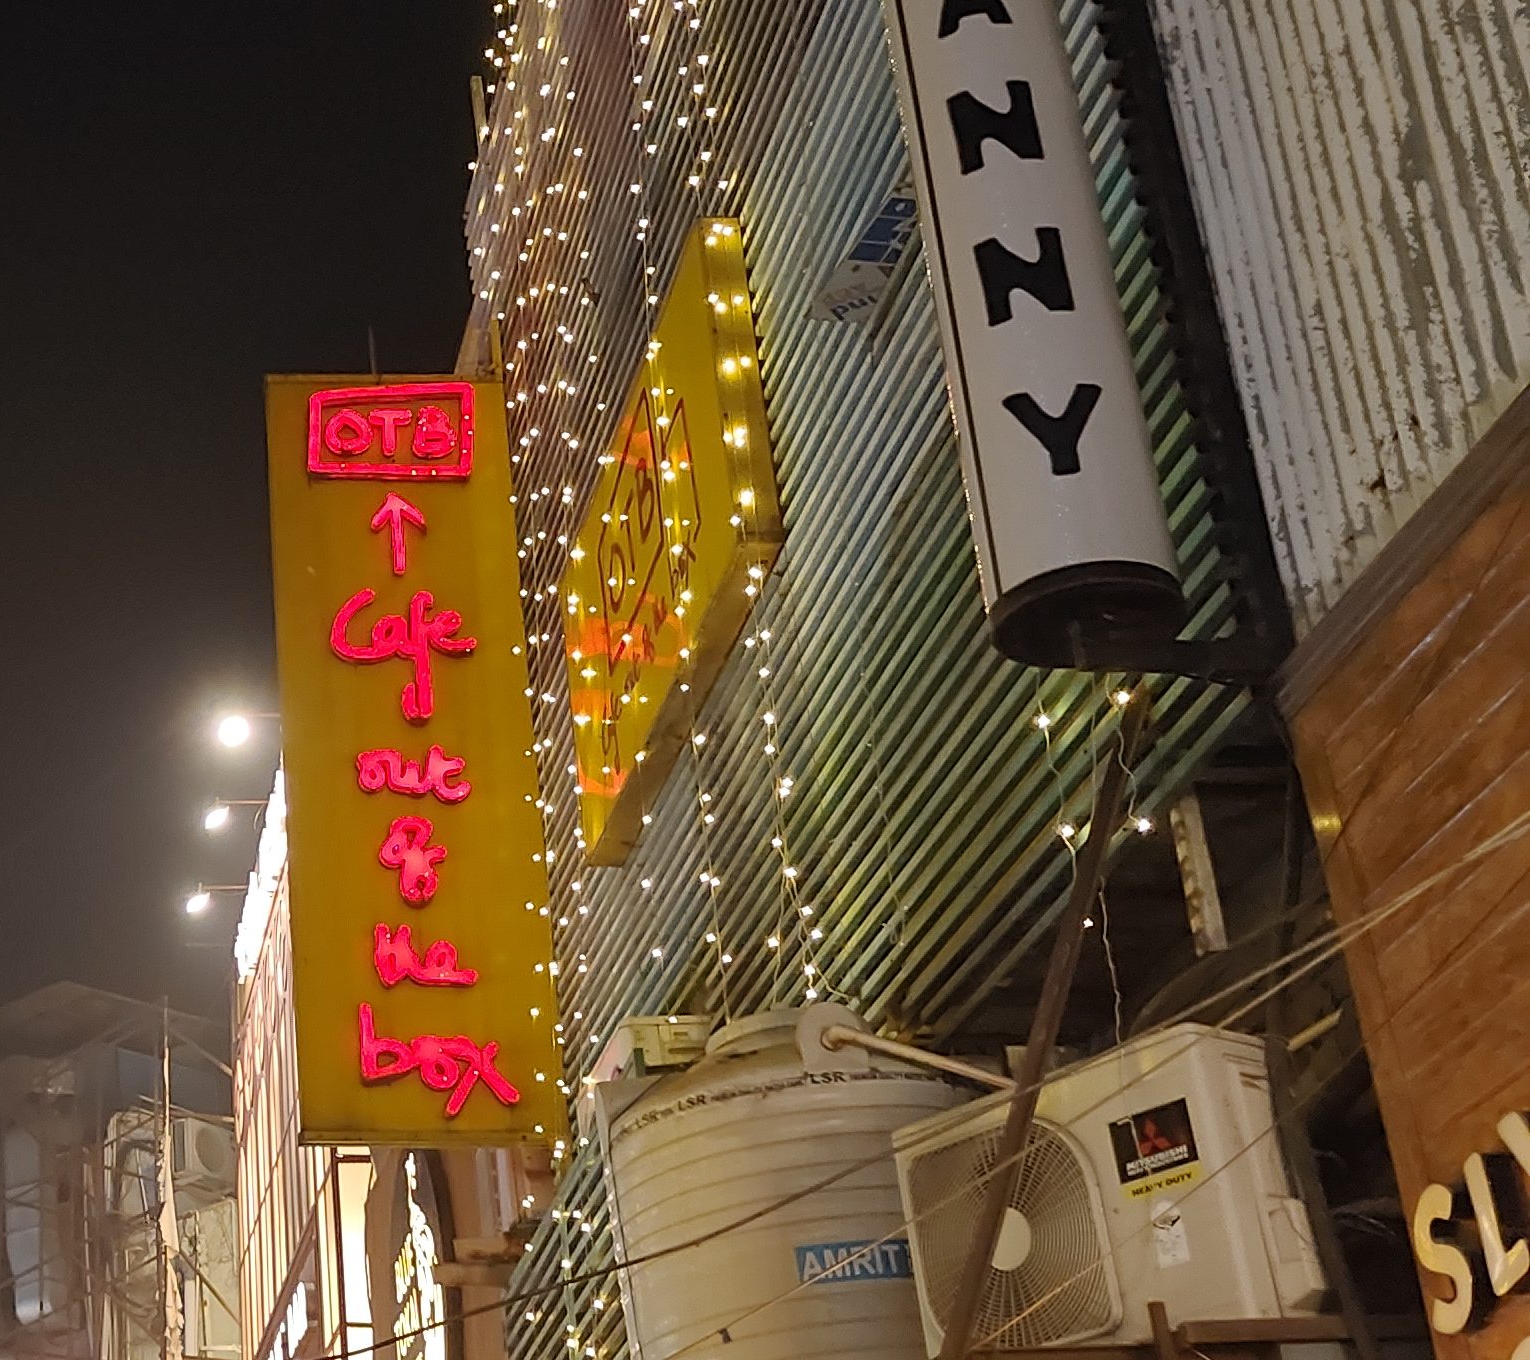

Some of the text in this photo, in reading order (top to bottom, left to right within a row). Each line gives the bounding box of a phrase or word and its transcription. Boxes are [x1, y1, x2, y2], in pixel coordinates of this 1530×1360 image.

[325, 405, 459, 458] OTB
[609, 457, 653, 614] OTB
[330, 589, 477, 721] Cafe
[356, 744, 471, 804] out
[358, 1001, 520, 1118] box
